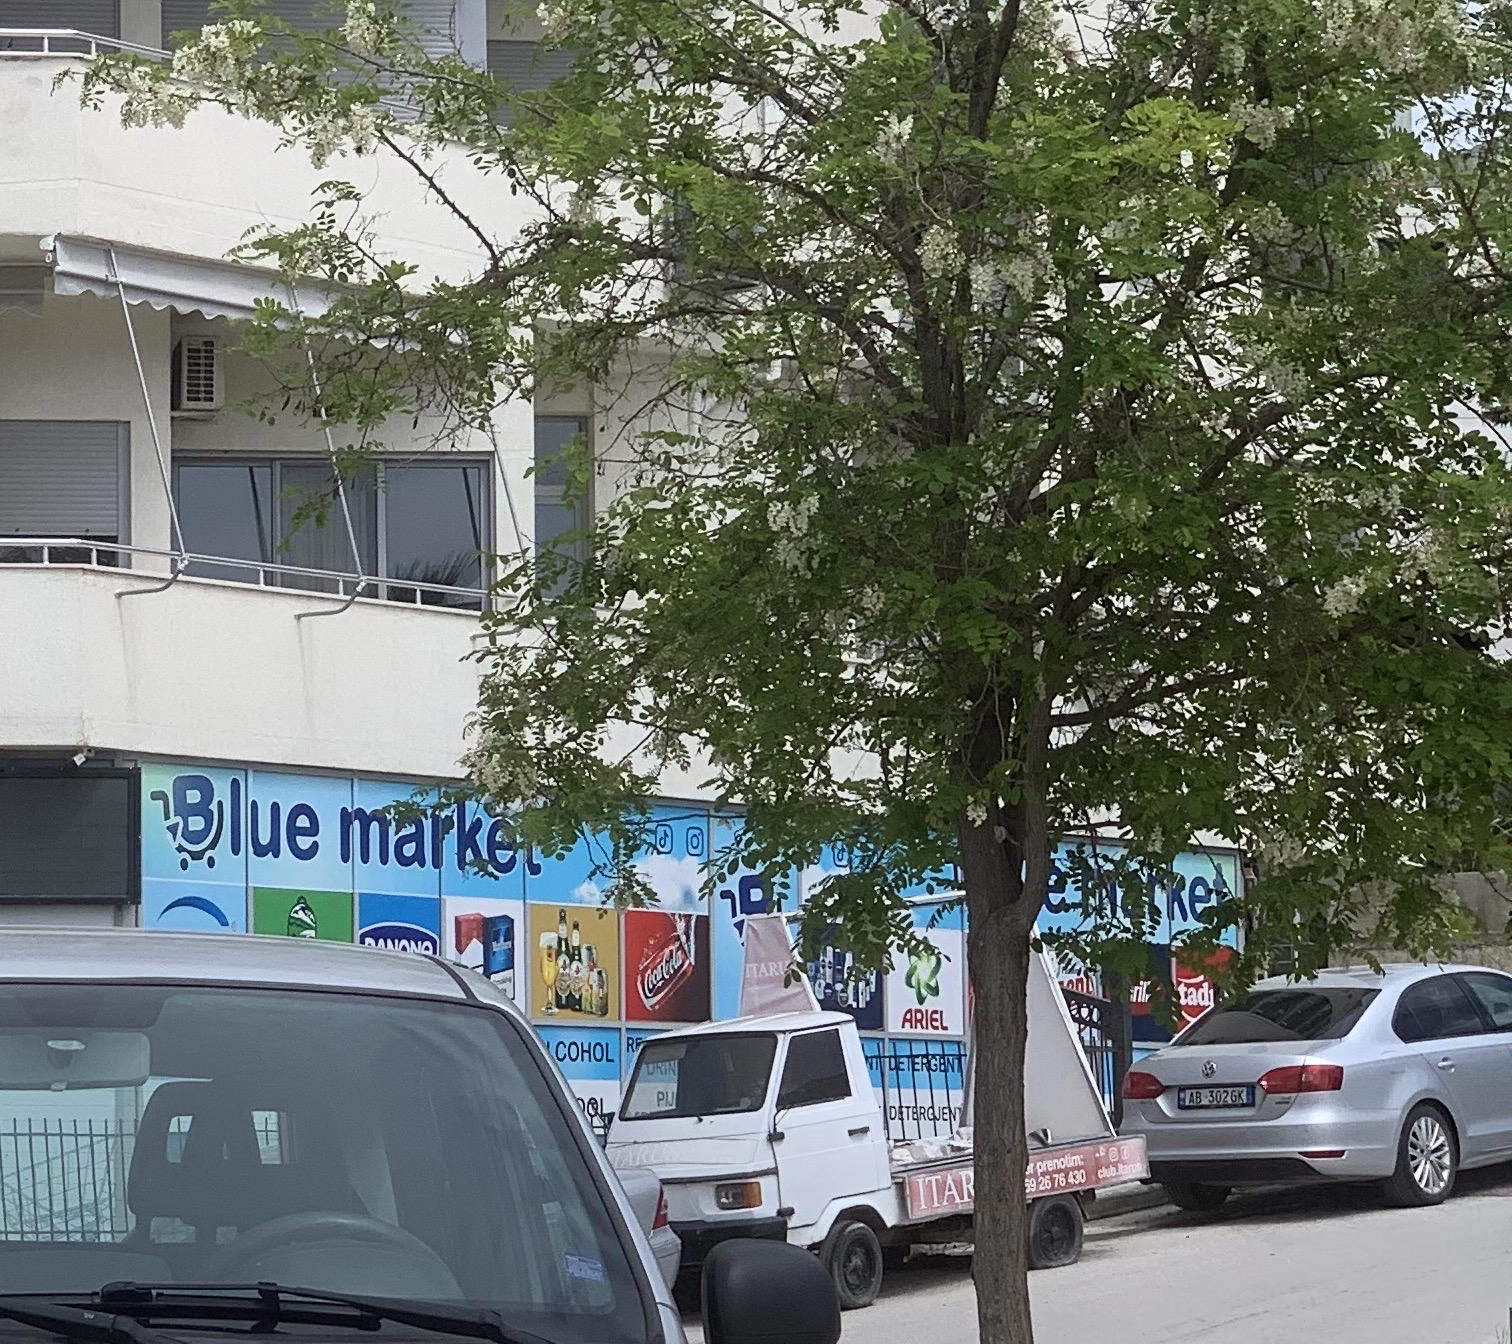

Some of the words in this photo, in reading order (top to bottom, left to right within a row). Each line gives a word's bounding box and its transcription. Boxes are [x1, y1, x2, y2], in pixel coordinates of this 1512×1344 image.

[172, 773, 320, 862] Blue
[901, 1007, 949, 1031] ARIEL
[1188, 1091, 1202, 1105] AB
[1038, 1175, 1052, 1191] 26
[1053, 1172, 1067, 1188] 76
[1068, 1169, 1087, 1185] 430
